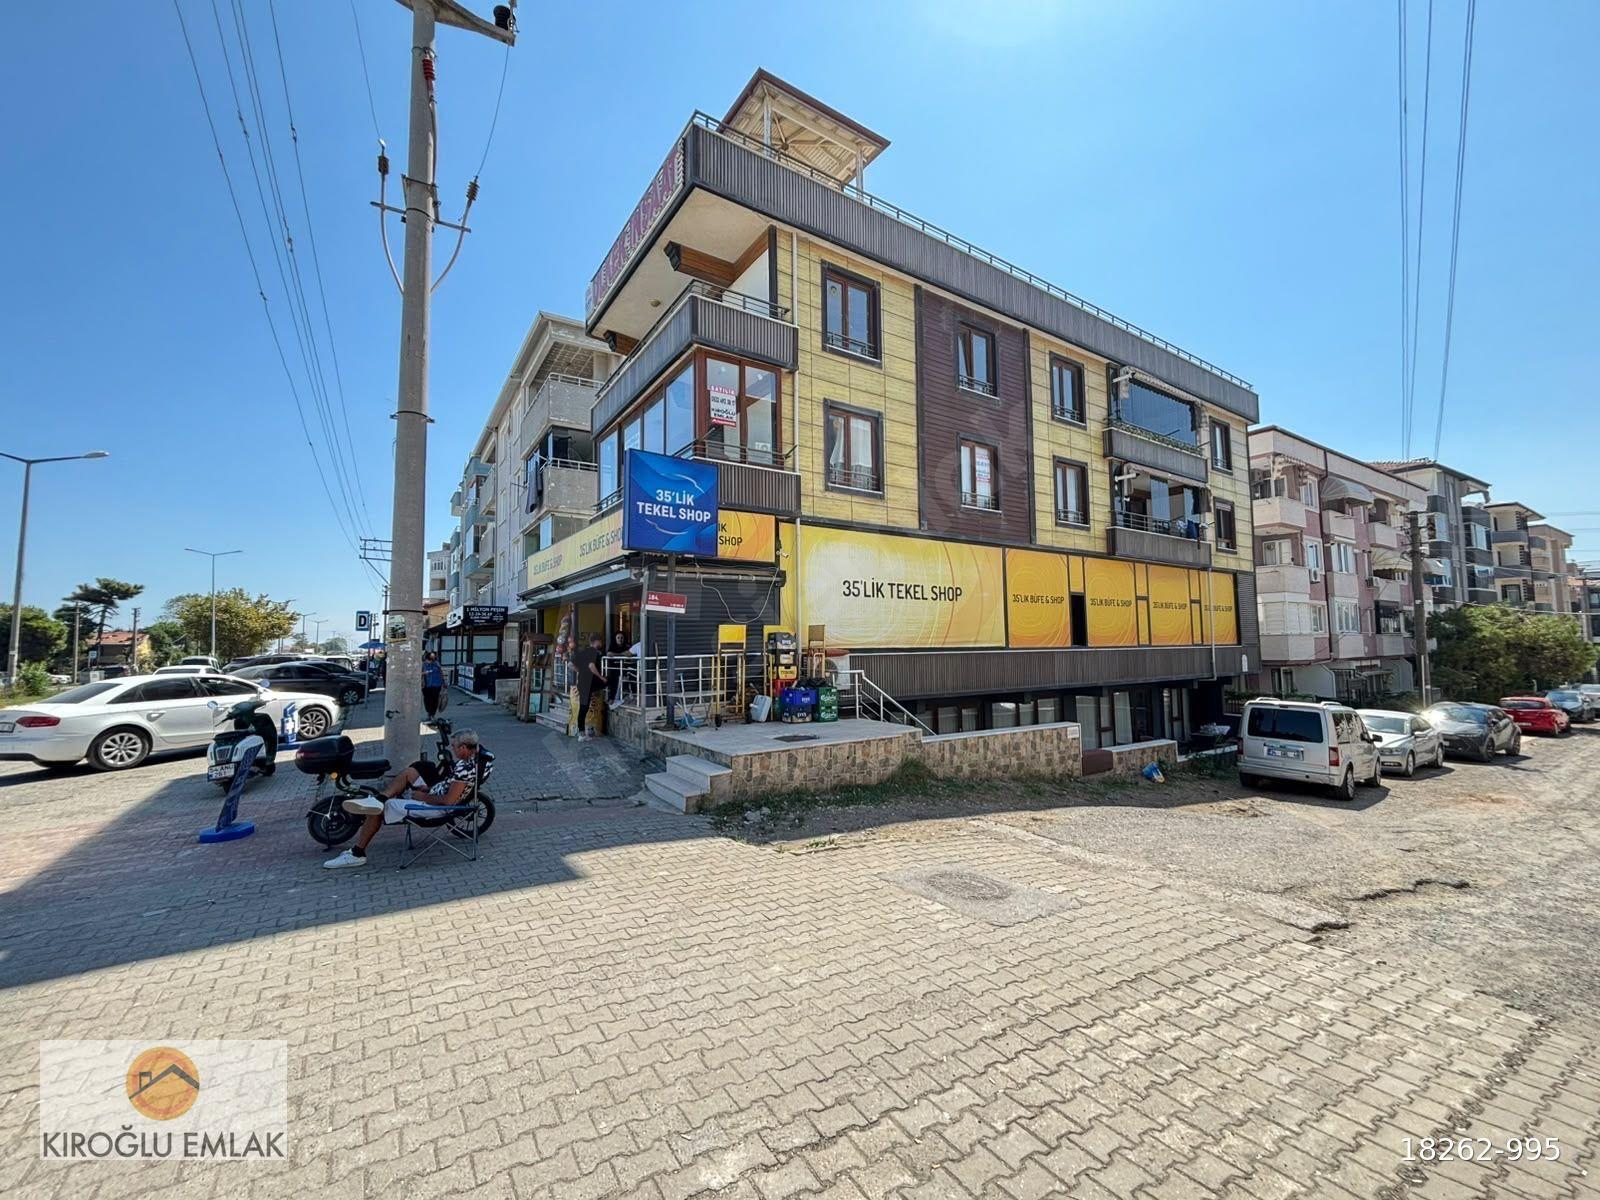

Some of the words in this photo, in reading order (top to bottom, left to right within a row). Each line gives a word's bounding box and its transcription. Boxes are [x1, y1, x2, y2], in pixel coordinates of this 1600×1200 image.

[656, 489, 695, 506] 35'LİK
[637, 502, 676, 519] TEKEL
[678, 508, 711, 523] SHOP
[718, 535, 743, 546] SHOP
[842, 577, 885, 598] 35'LİK
[887, 582, 928, 600] TEKEL
[930, 585, 963, 602] SHOP
[1050, 595, 1065, 604] SHOP
[1120, 599, 1133, 608] SHOP
[358, 615, 367, 627] D
